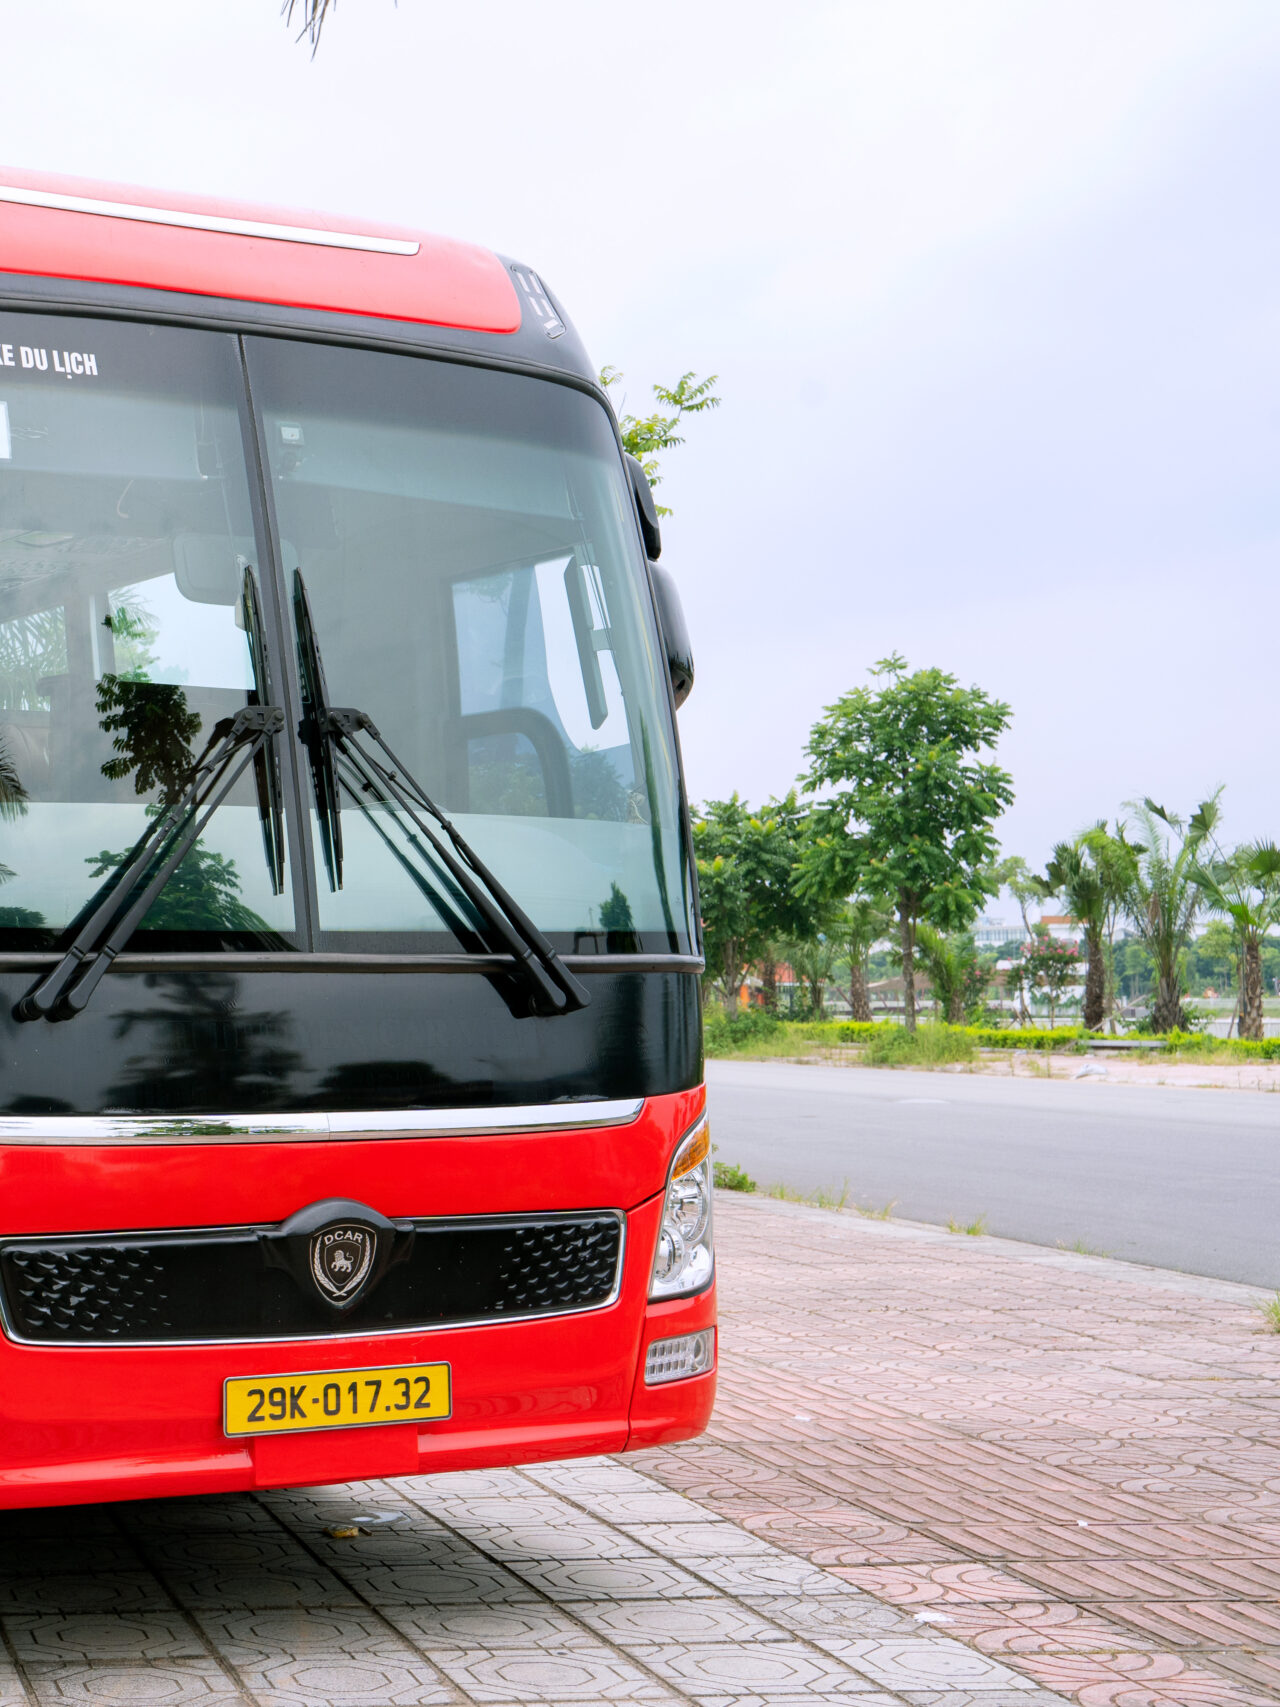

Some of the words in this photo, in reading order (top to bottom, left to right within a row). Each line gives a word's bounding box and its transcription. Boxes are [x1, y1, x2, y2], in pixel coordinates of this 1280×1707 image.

[20, 346, 48, 371] DU
[53, 350, 98, 379] LỊCH
[324, 1231, 363, 1246] DCAR
[246, 1375, 432, 1423] 29K-017.32
